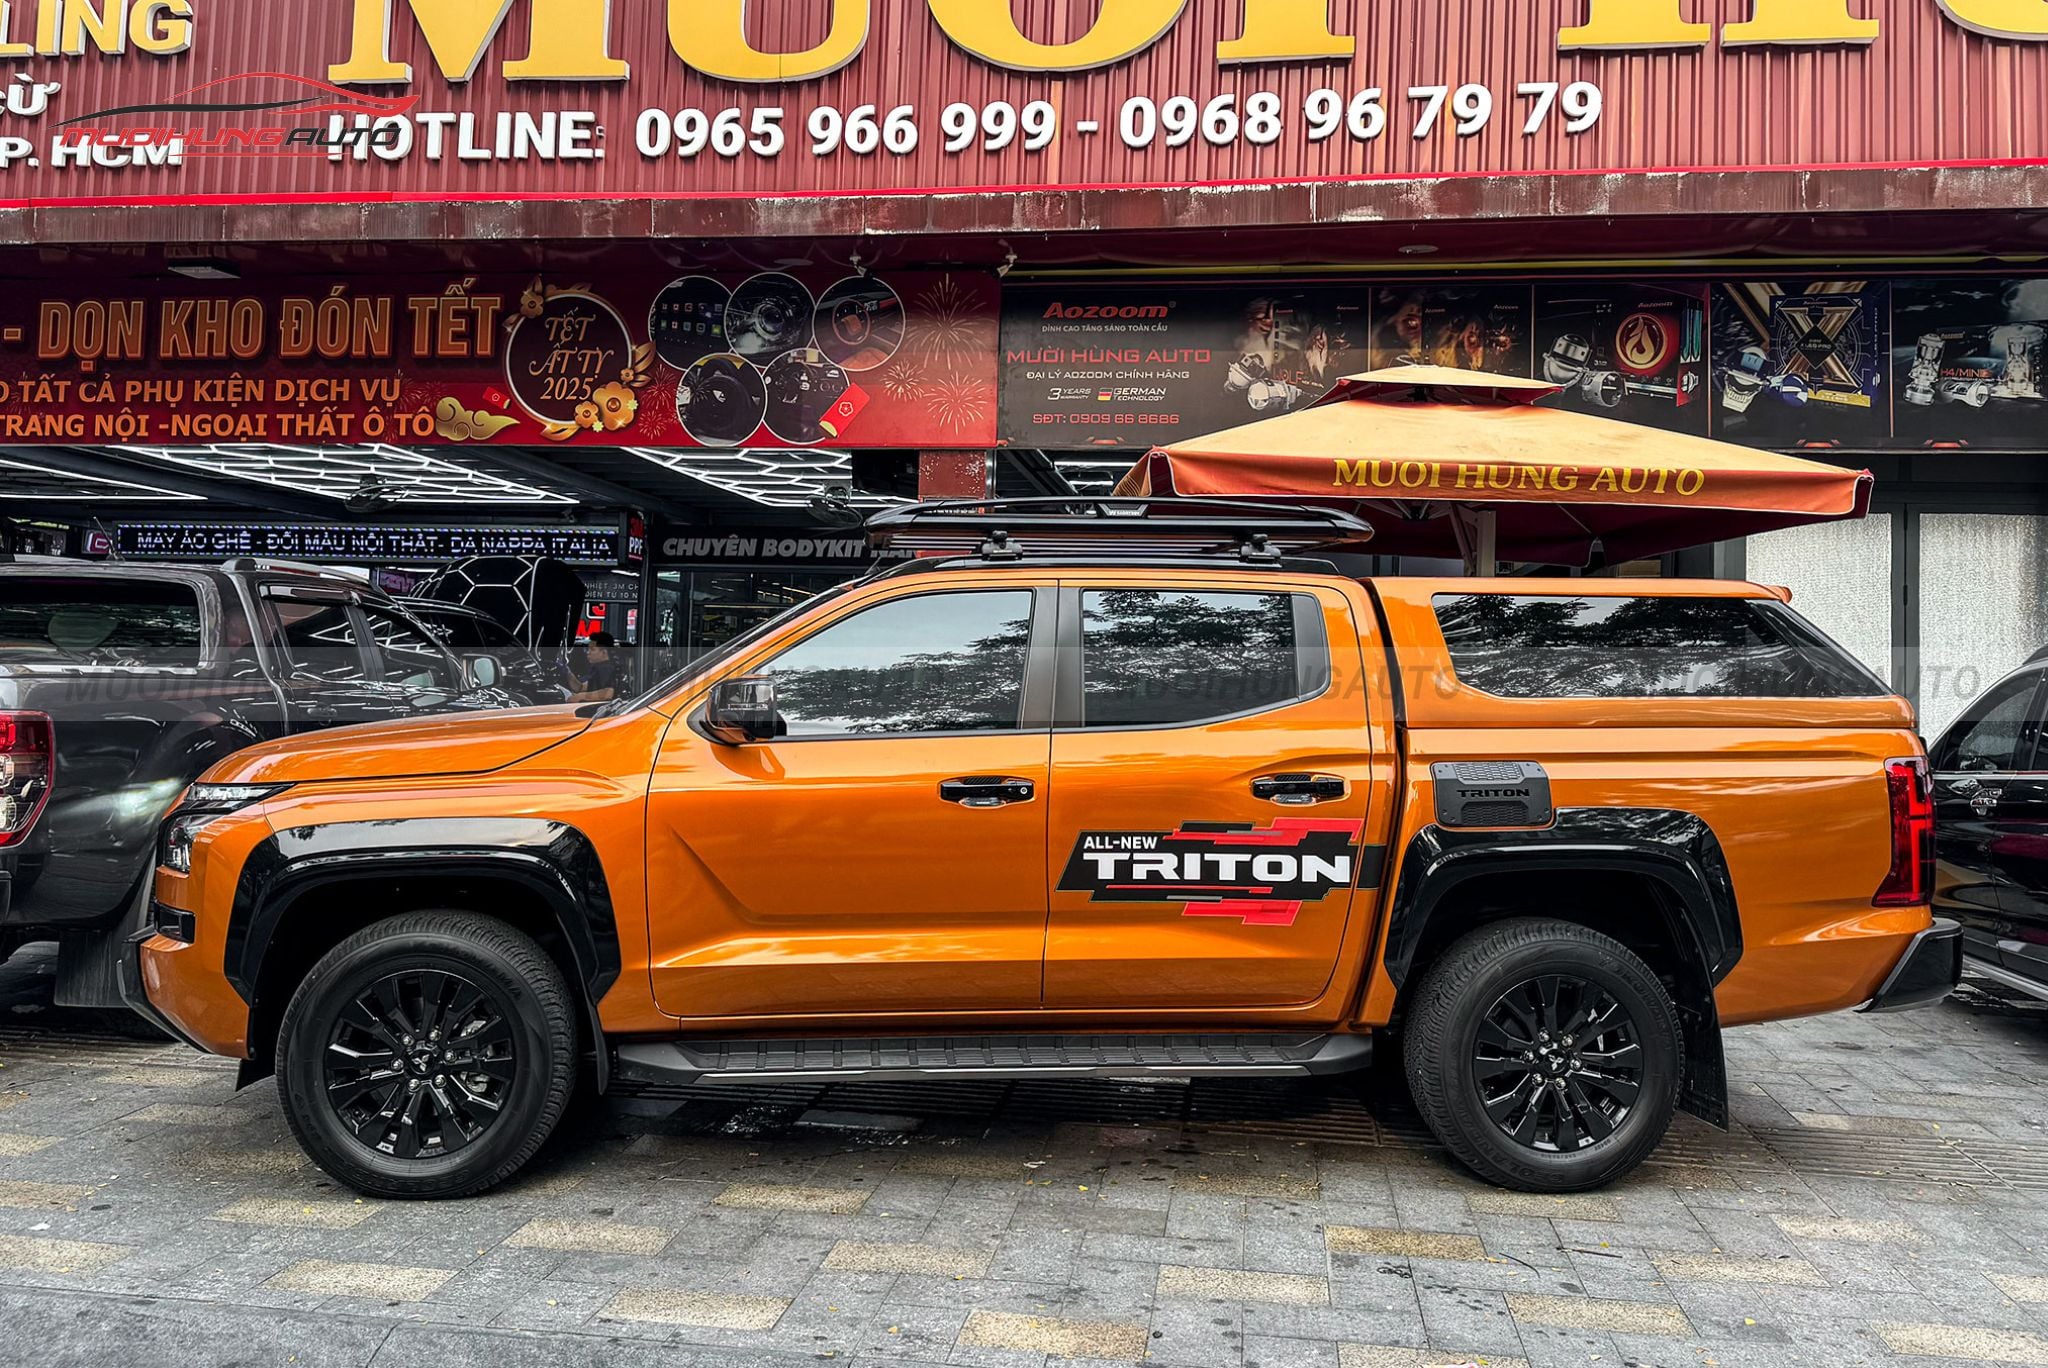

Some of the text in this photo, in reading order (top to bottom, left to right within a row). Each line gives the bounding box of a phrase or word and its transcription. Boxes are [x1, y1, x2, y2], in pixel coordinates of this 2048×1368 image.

[635, 106, 785, 158] 0965
[808, 104, 919, 157] 966
[940, 100, 1056, 153] 999
[1119, 91, 1283, 149] 0968
[1304, 87, 1385, 142] 96
[1408, 83, 1493, 139] 79
[1517, 80, 1603, 135] 79
[51, 133, 185, 169] HCM
[1042, 302, 1169, 319] Aozoom
[37, 299, 145, 373] DỌN
[159, 299, 265, 360] KHO
[279, 285, 392, 358] ĐÓN
[408, 277, 501, 358] TẾT
[545, 307, 597, 342] TẾT
[1006, 345, 1211, 364] MƯỜI HÙNG AUTO
[1026, 371, 1045, 381] ĐẠI
[1048, 369, 1061, 379] LÝ
[1063, 371, 1113, 379] AOZOOM
[1116, 369, 1153, 379] CHÍNH
[18, 373, 71, 403] TẤT
[78, 373, 116, 403] CẢ
[125, 379, 184, 408] PHỤ
[194, 372, 265, 408] KIỆN
[275, 379, 350, 408] DỊCH
[360, 378, 401, 407] VỤ
[540, 376, 594, 401] 2025
[1048, 387, 1092, 400] 3 YEARS
[1113, 387, 1167, 395] GERMAN
[94, 406, 150, 442] NỘI
[276, 406, 355, 437] THẤT
[363, 405, 385, 437] Ô
[394, 405, 435, 437] TÔ
[1032, 414, 1180, 424] SĐT: 0909 66 8686
[1332, 458, 1706, 497] MUOI HUNG AUTO
[137, 531, 177, 549] MAY
[662, 533, 758, 557] CHUYÊN
[761, 538, 867, 558] BODYKIT
[1456, 788, 1531, 799] TRITON
[1083, 835, 1158, 850] ALL-NEW
[1082, 852, 1352, 884] TRITON
